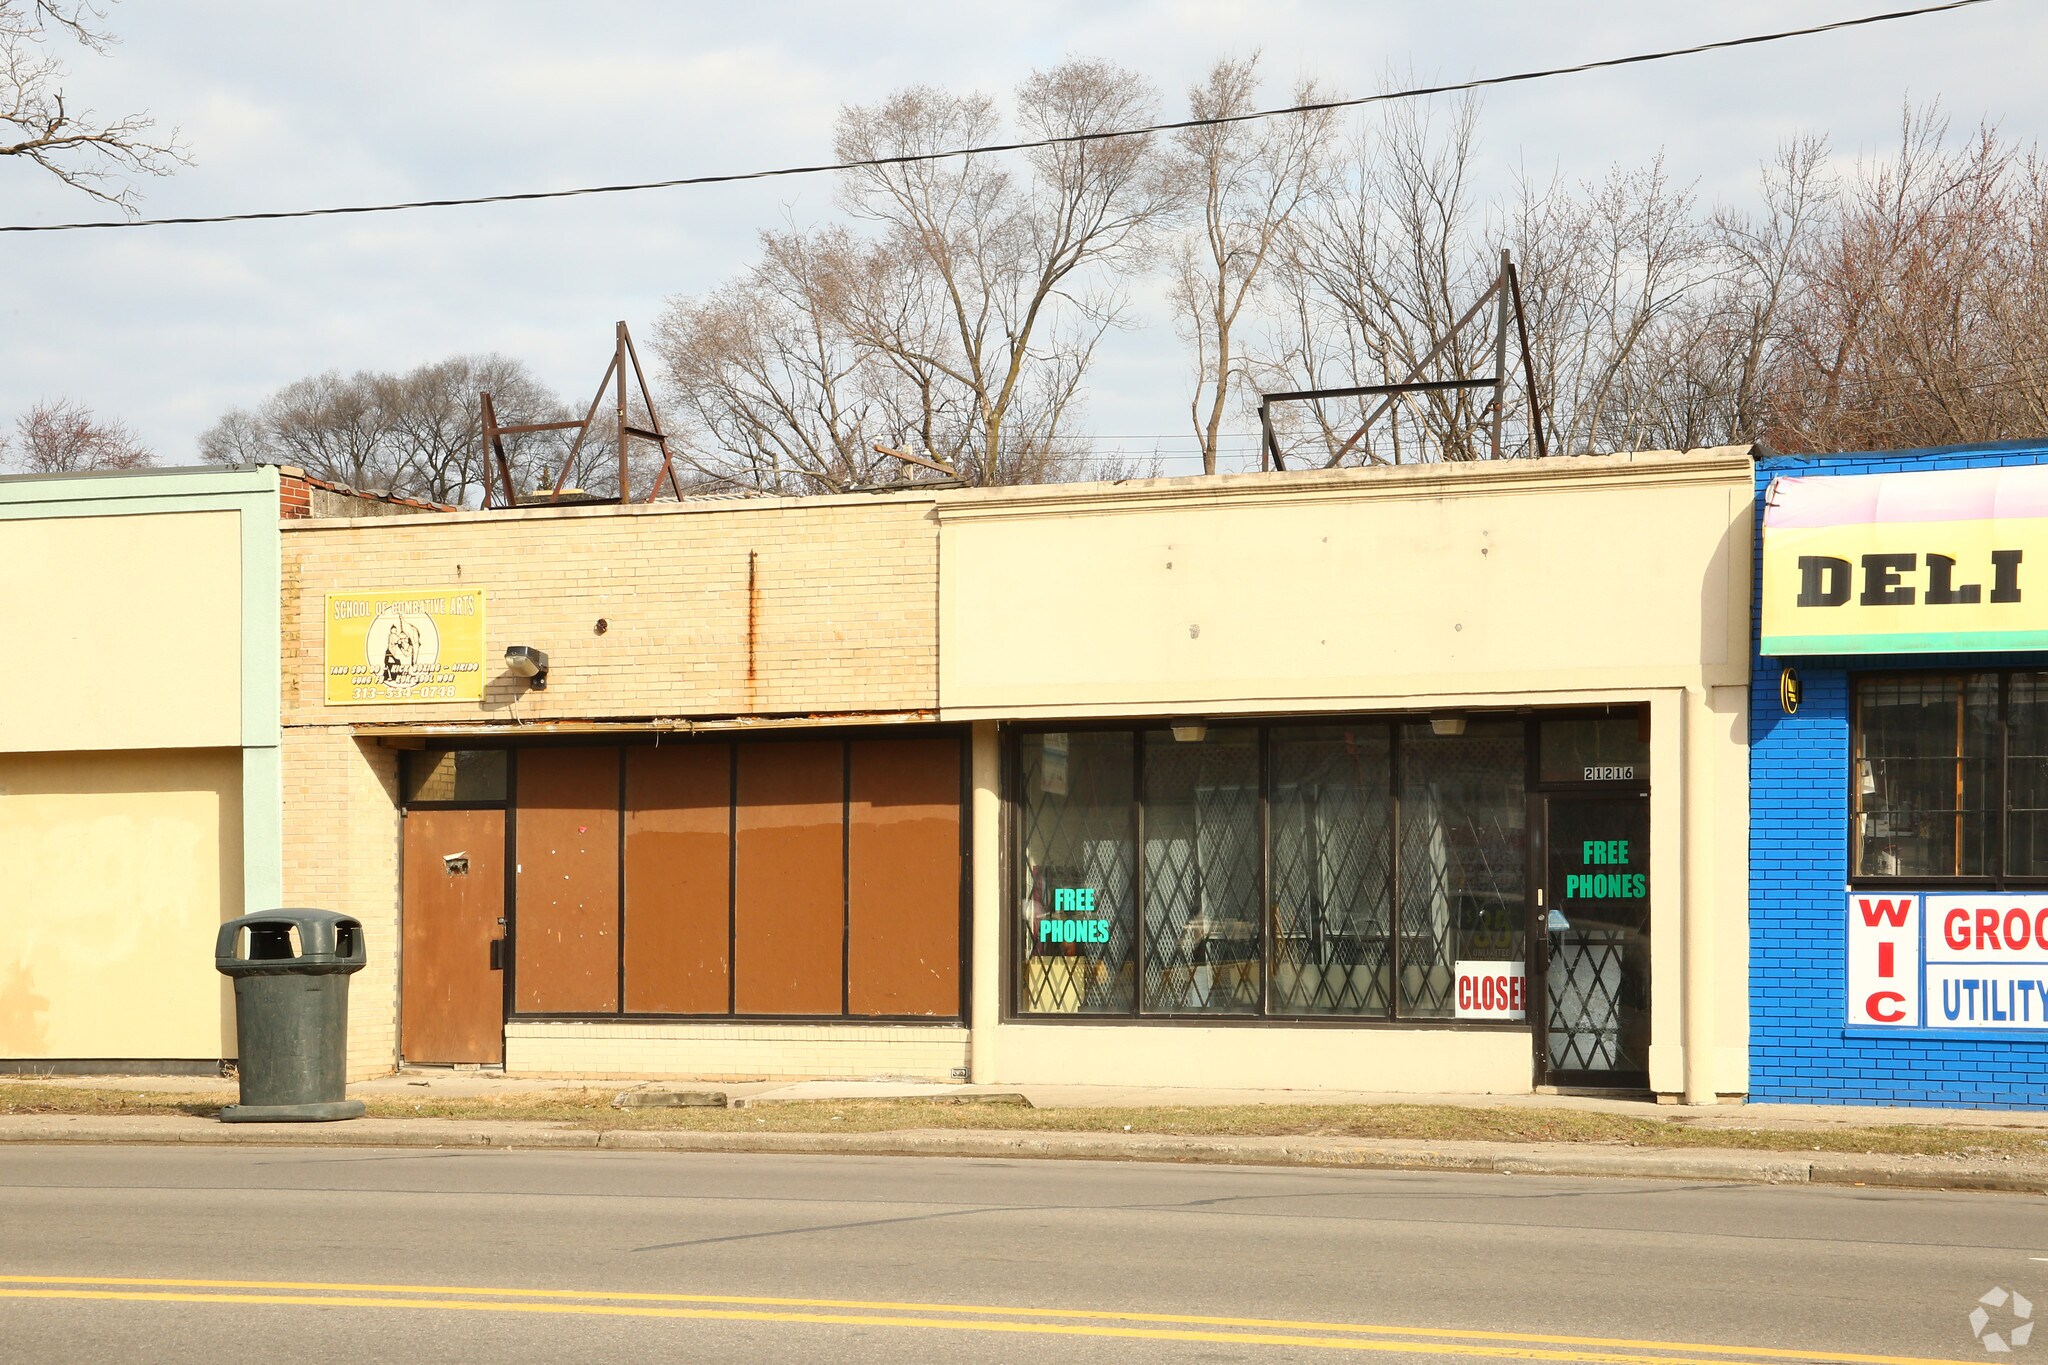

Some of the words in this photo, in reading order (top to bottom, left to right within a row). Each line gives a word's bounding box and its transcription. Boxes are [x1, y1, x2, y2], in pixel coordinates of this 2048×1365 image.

[1797, 550, 2022, 607] DELI
[334, 600, 371, 620] SCHOOL
[375, 601, 389, 616] OF
[393, 598, 446, 616] COMBATIVE
[450, 595, 475, 616] ARTS
[330, 666, 349, 675] TANG
[351, 666, 367, 674] SOO
[370, 665, 381, 674] DO
[391, 664, 410, 673] KICK
[413, 663, 441, 674] BOXING
[452, 662, 479, 673] AIKIDO
[374, 675, 385, 684] FU
[414, 674, 434, 684] SOOL
[437, 673, 455, 683] WON
[352, 685, 456, 700] 313-534-0748
[1585, 767, 1633, 780] 21216
[1583, 841, 1629, 865] FREE
[1566, 873, 1646, 899] PHONES
[1054, 888, 1095, 911] FREE
[1040, 919, 1110, 943] PHONES
[1858, 899, 1912, 1022] WIC
[1943, 979, 2048, 1021] UTILITY
